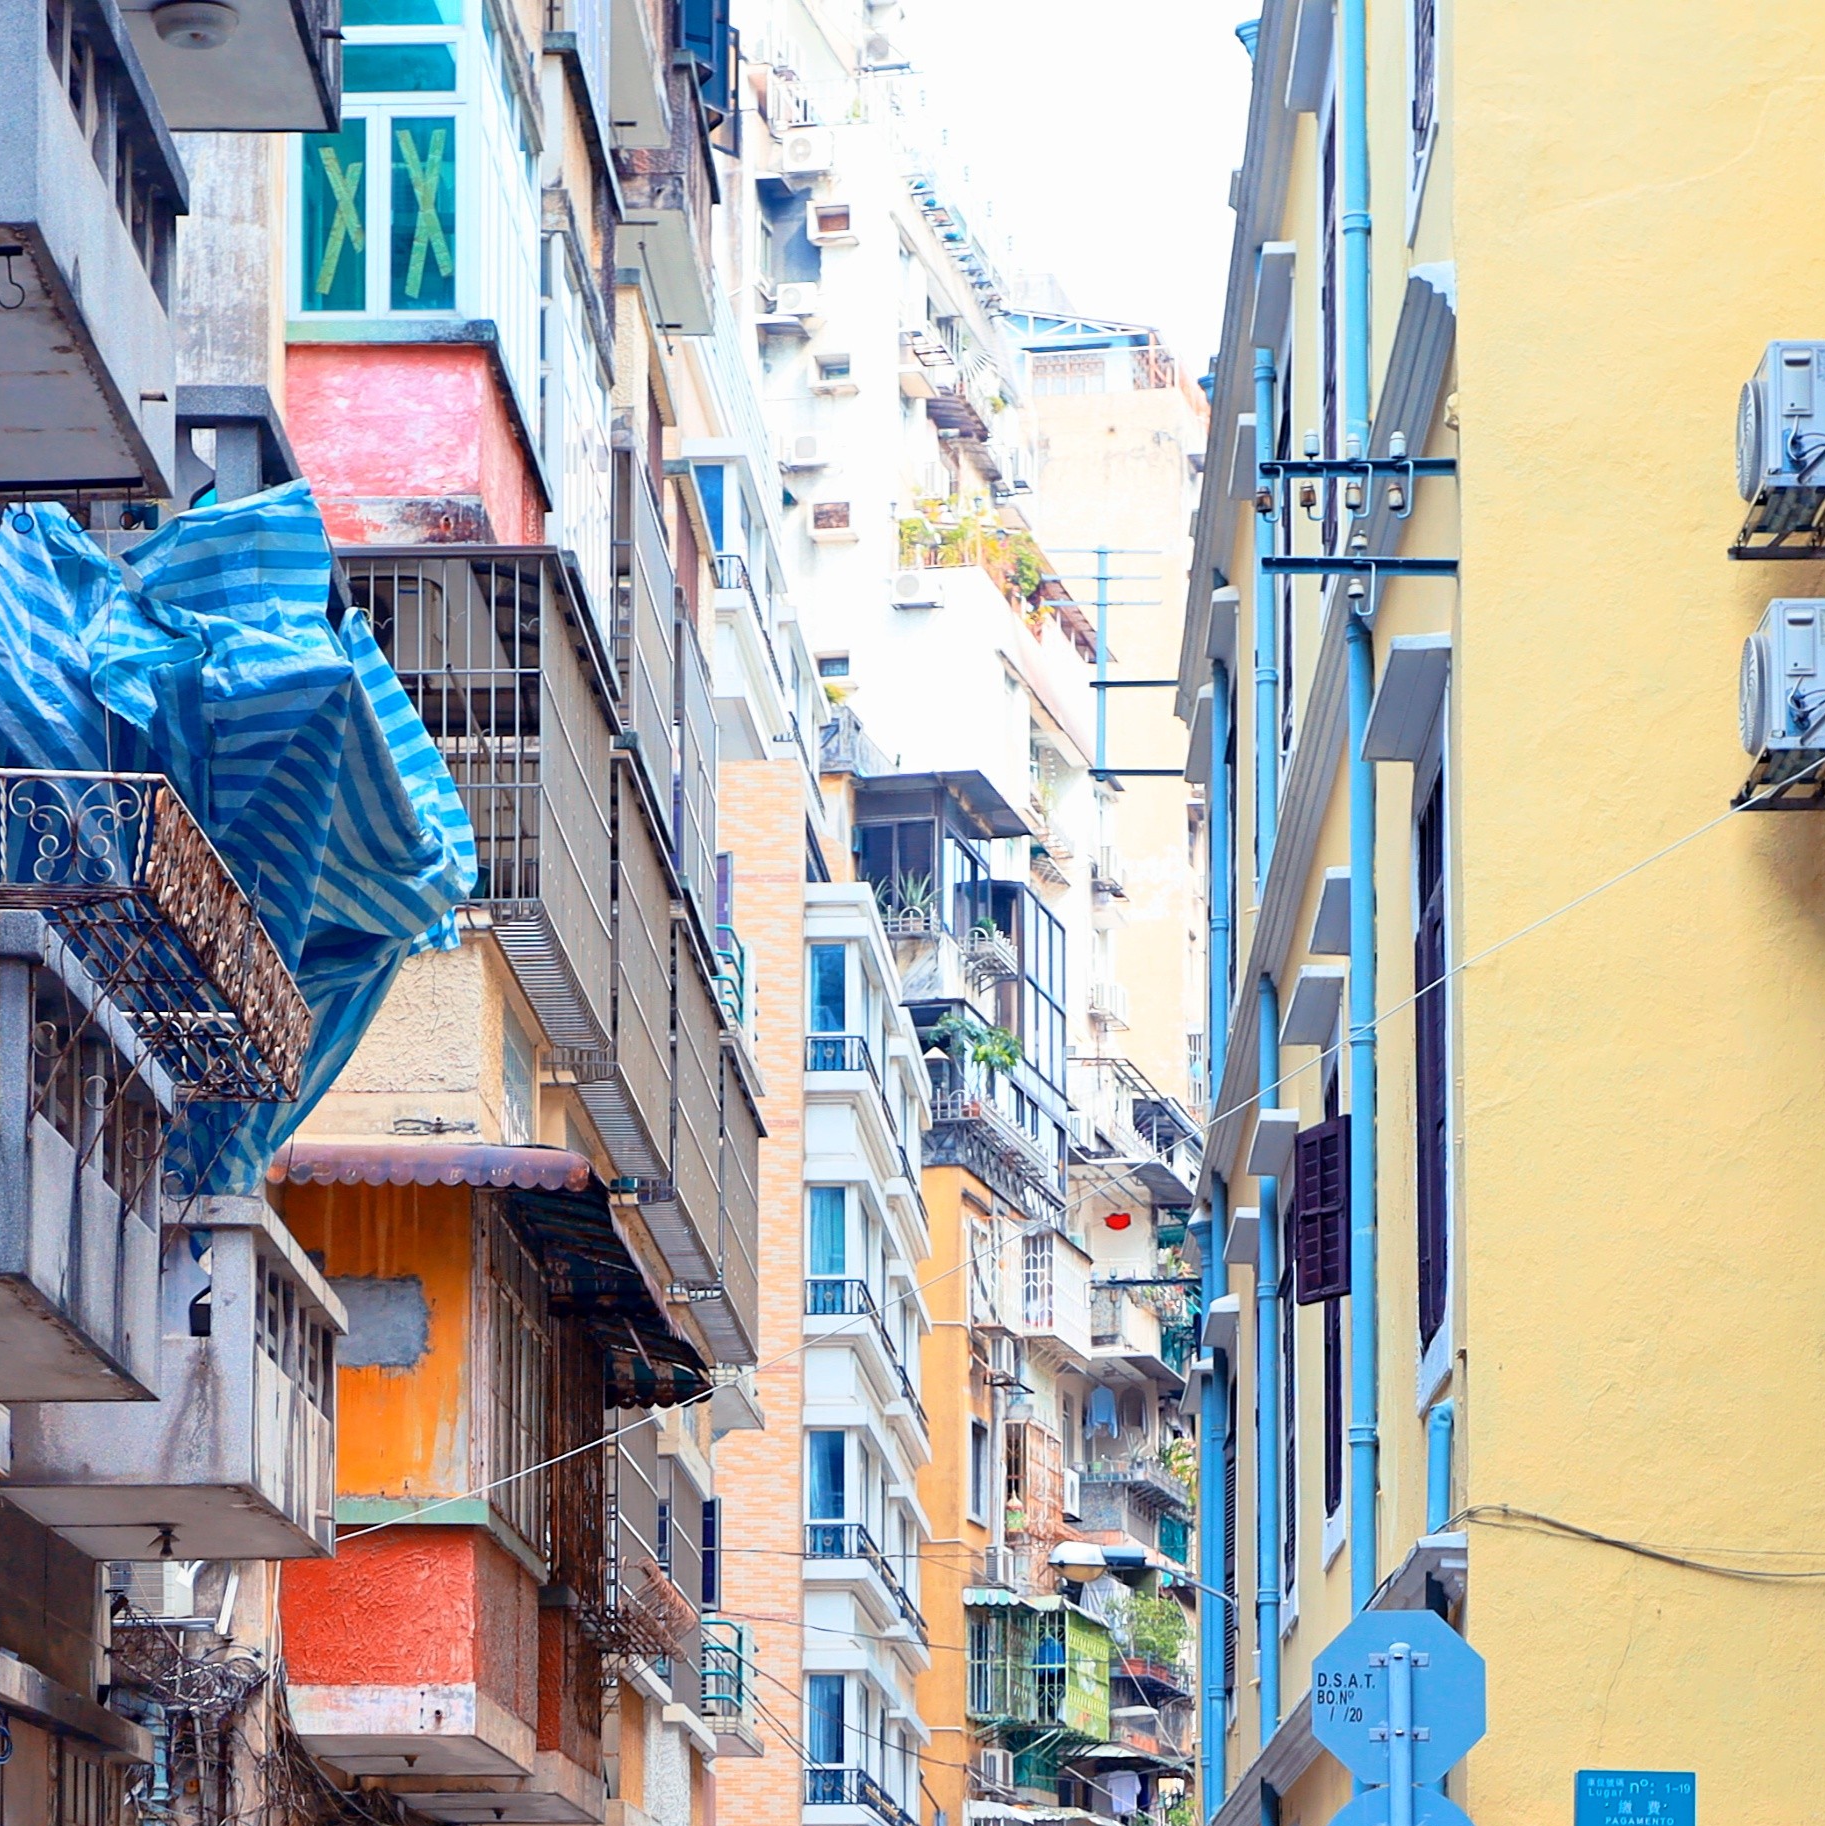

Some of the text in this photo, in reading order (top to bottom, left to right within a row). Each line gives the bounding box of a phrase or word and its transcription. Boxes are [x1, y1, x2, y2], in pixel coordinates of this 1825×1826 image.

[1317, 1672, 1376, 1689] D.S.A.T.
[1588, 1788, 1624, 1799] Lugar
[1665, 1783, 1691, 1795] 1-19
[1605, 1816, 1675, 1826] PAGAMENTO
